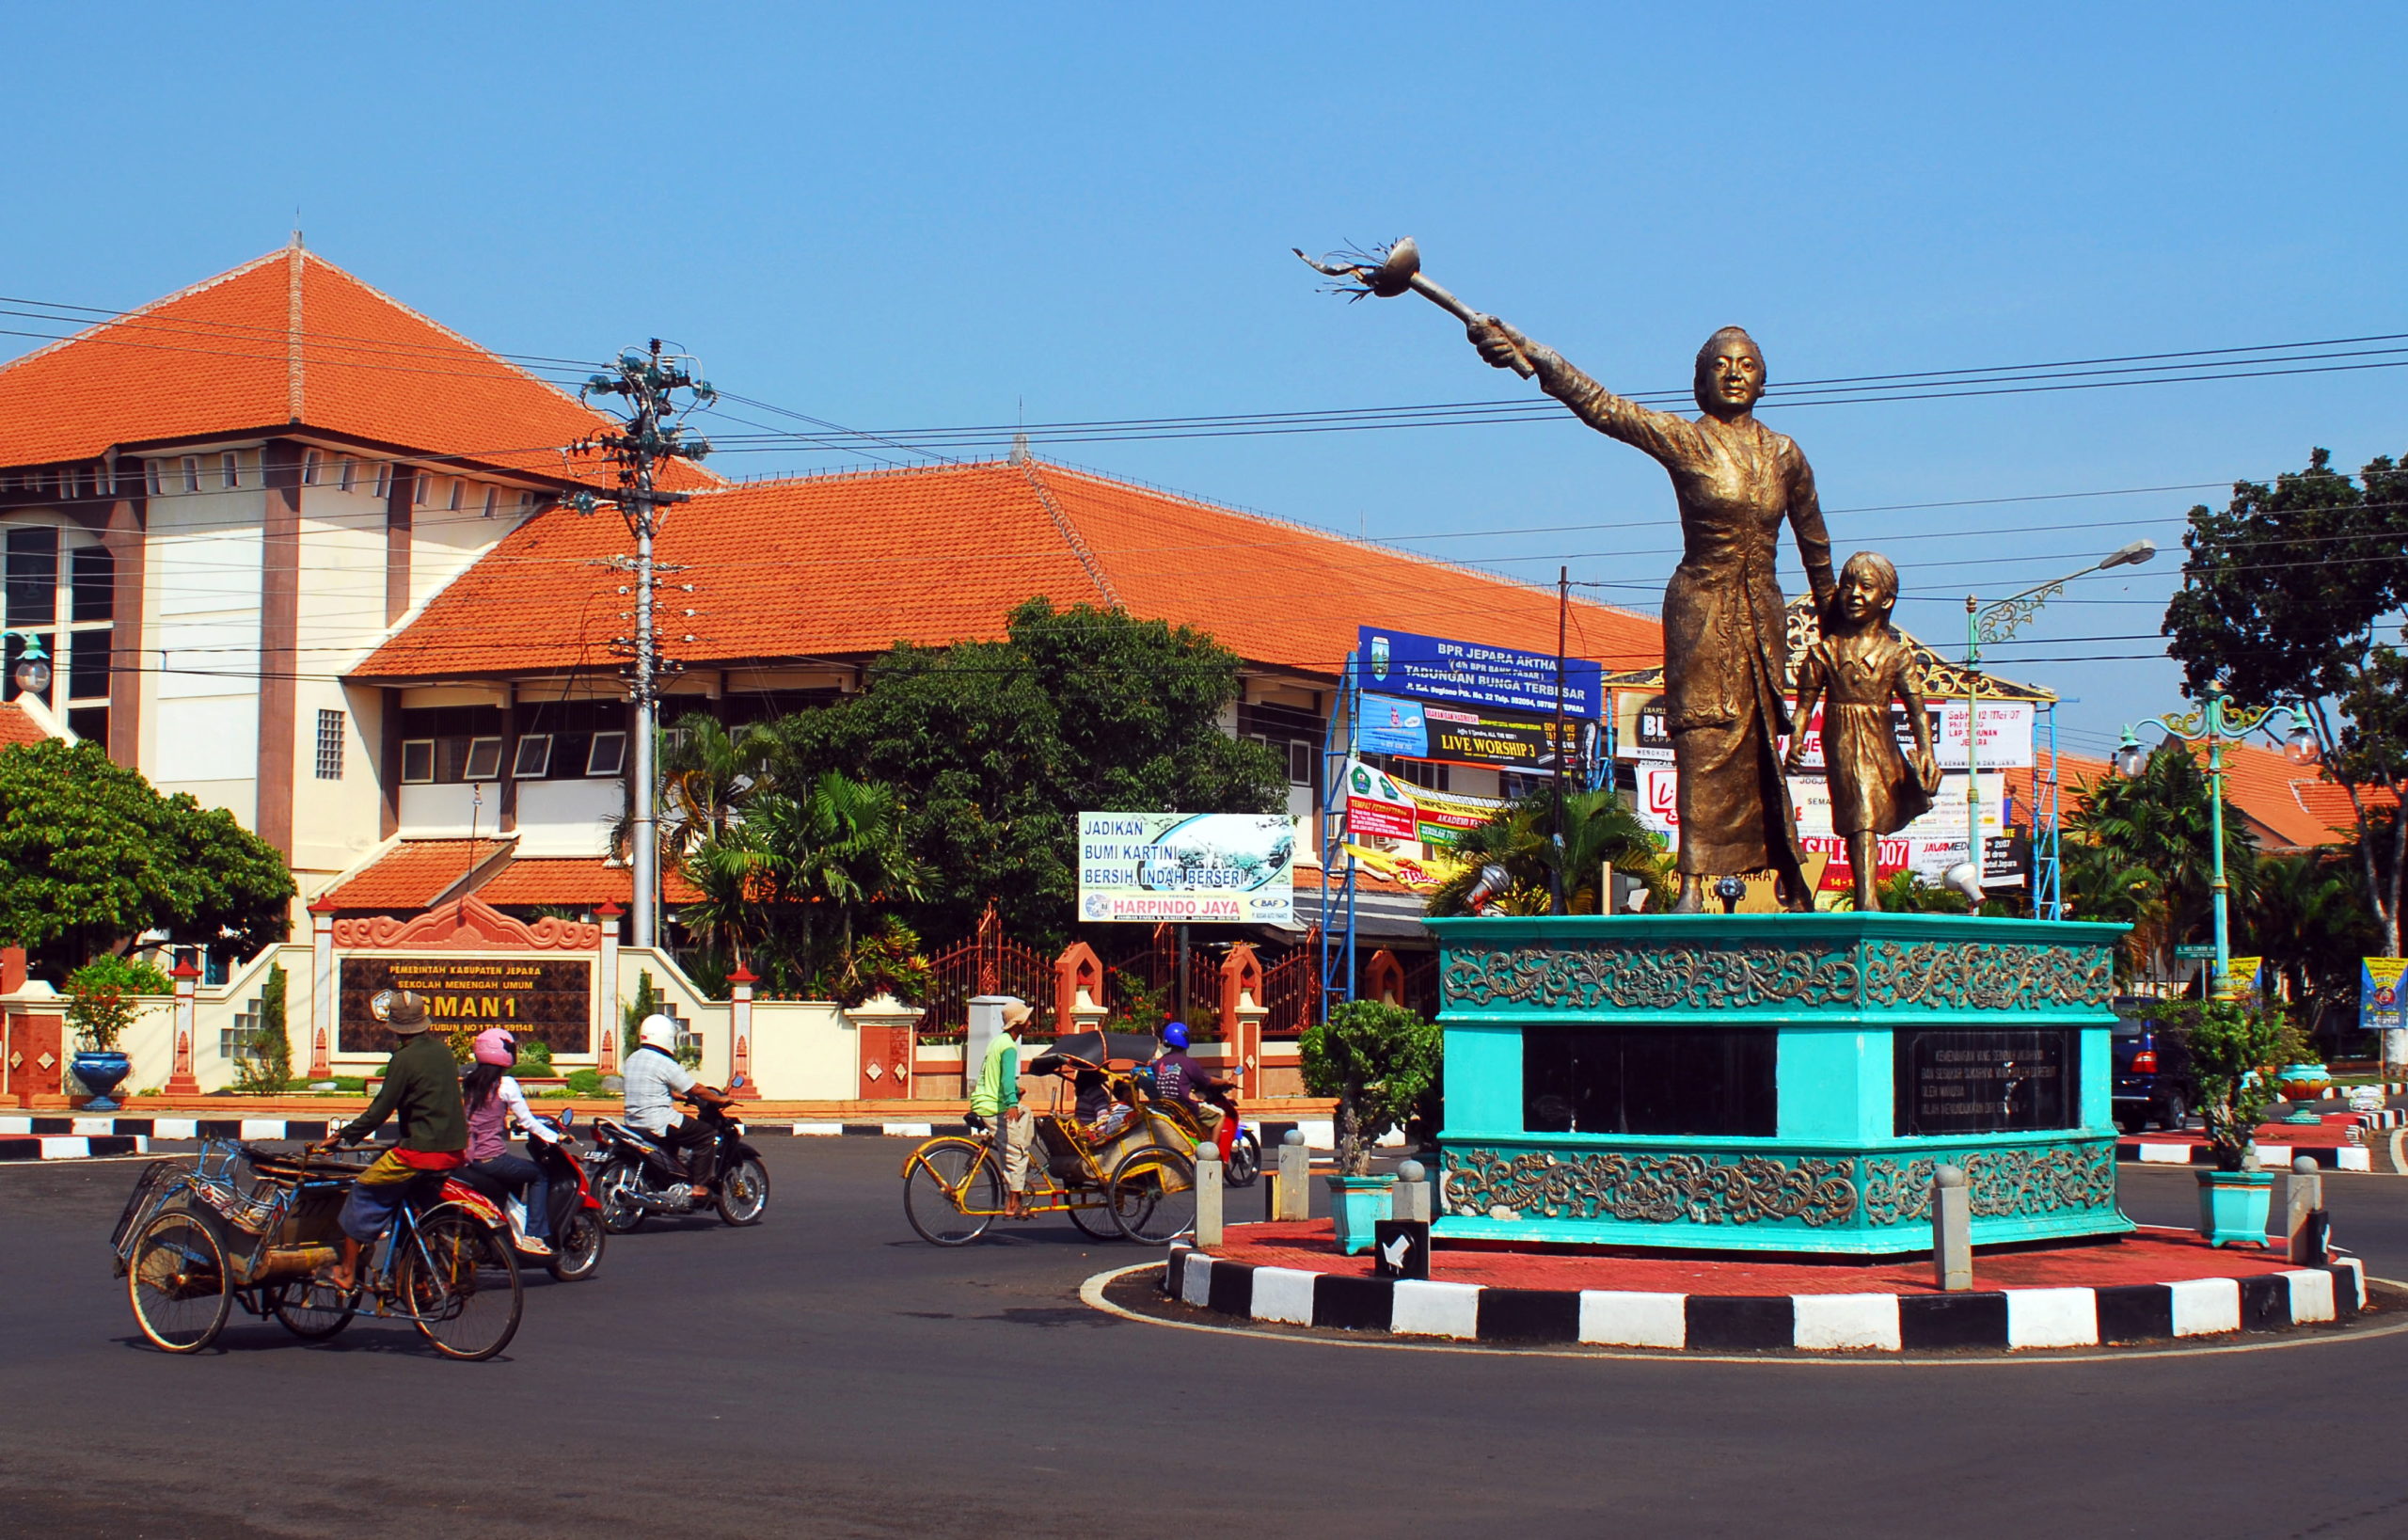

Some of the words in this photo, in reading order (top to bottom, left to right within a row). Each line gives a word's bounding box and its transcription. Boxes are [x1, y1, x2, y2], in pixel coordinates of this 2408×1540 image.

[1438, 643, 1463, 658] BPR
[1466, 648, 1514, 665] JEPARA
[1516, 657, 1558, 672] ARTHA
[1404, 665, 1475, 685] TABUNGAN
[1478, 675, 1520, 691] BUNGA
[1523, 683, 1585, 701] TERBSAR
[1643, 715, 1668, 738] BL
[1441, 735, 1472, 752] LIVE
[1473, 738, 1528, 757] WORSHIP
[1529, 744, 1535, 757] 3
[1085, 820, 1143, 835] JADIKAN
[1085, 845, 1117, 860] BUMI
[1123, 845, 1177, 860] KARTINI
[1142, 869, 1183, 884] INDAH
[1188, 870, 1244, 884] BERSERI
[1114, 900, 1196, 914] HARPINDO
[1201, 900, 1241, 915] JAYA
[389, 966, 447, 975] PEMERINTAH
[450, 966, 502, 975] KABUPATEN
[506, 967, 542, 976] JEPARA
[398, 980, 441, 989] SEKOLAH
[445, 980, 499, 990] MENENGAH
[502, 981, 533, 990] UMUM
[464, 1024, 477, 1032] NO
